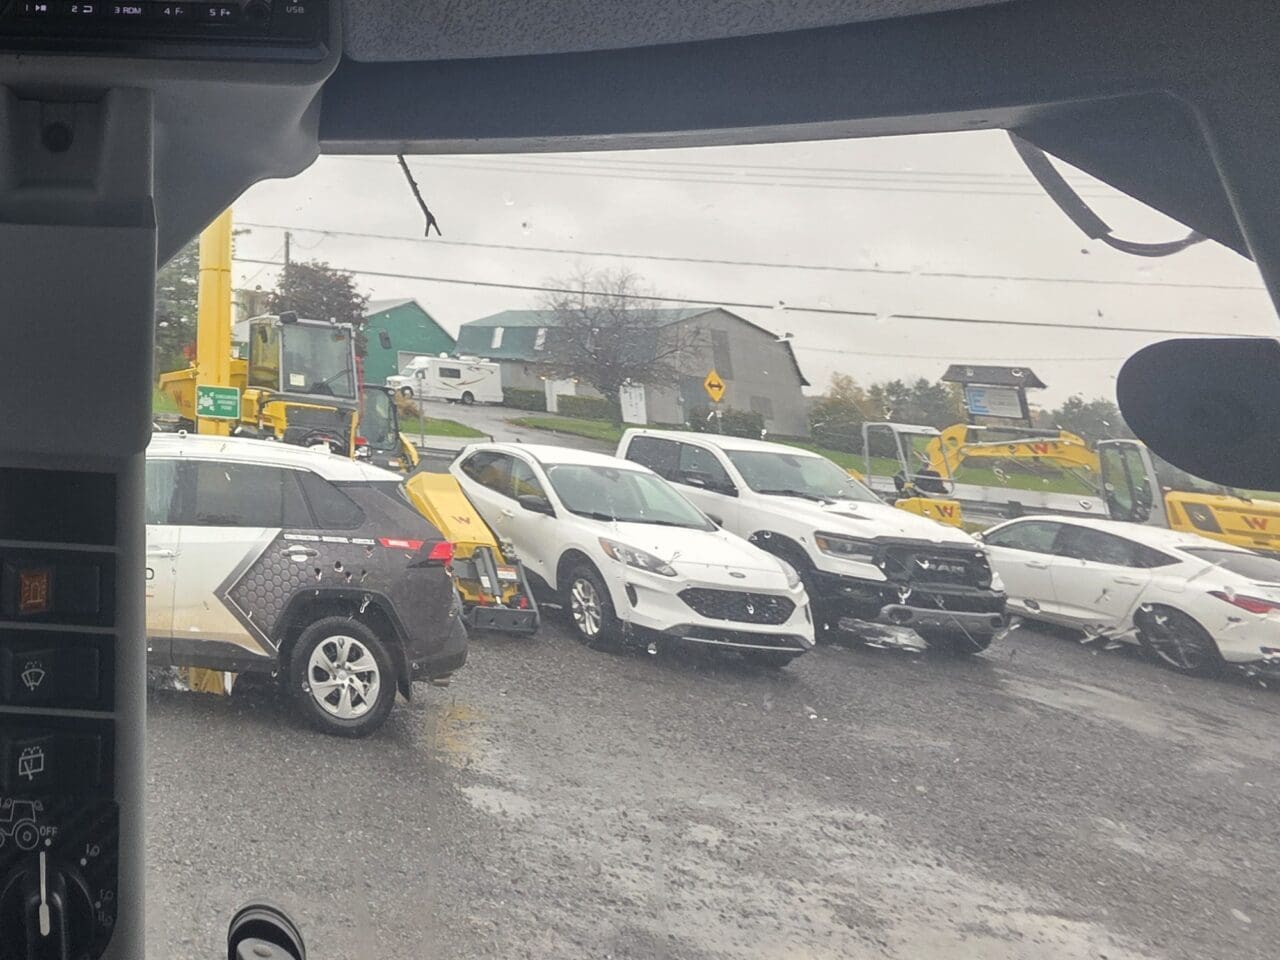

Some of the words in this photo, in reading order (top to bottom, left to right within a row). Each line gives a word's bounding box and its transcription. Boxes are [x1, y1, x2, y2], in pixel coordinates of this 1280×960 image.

[71, 5, 78, 13] 2
[114, 6, 121, 14] 3
[122, 6, 142, 15] RDM
[286, 6, 305, 14] USB
[39, 825, 58, 837] OFF
